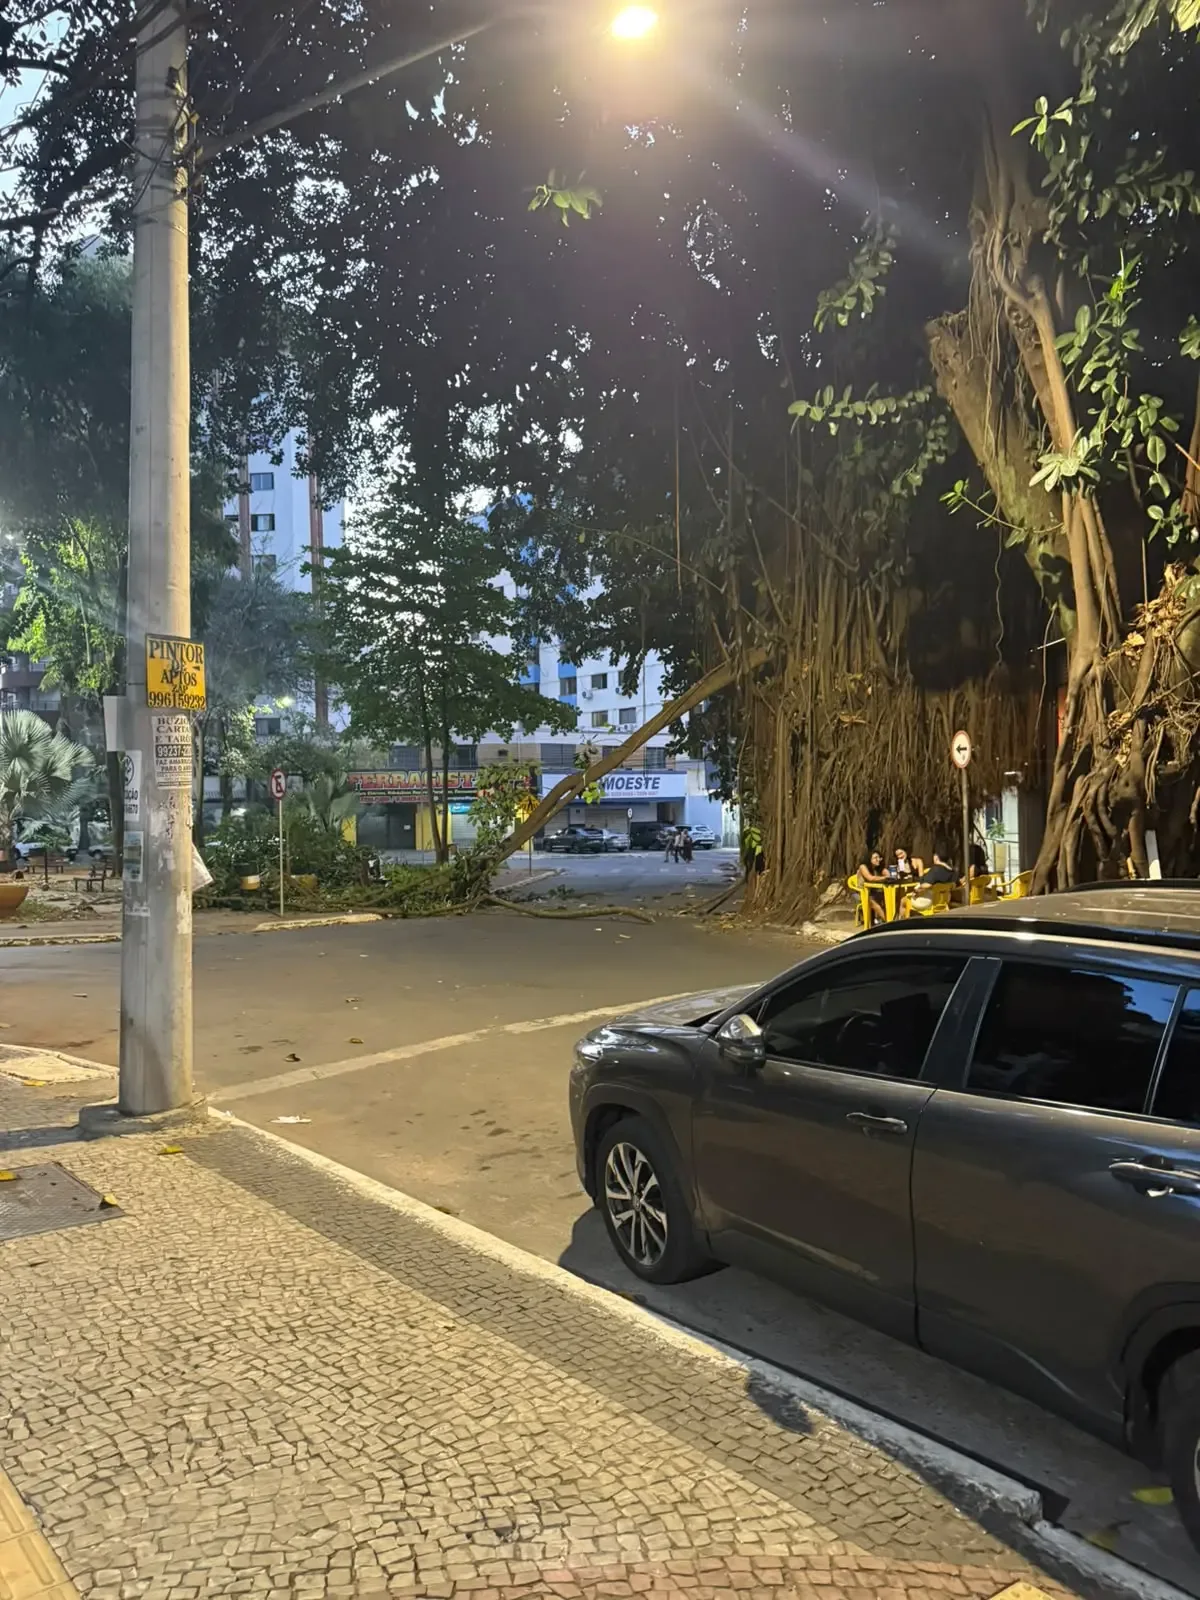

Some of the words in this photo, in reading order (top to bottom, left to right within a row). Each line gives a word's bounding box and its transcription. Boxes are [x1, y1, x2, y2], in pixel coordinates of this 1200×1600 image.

[149, 639, 204, 665] PINTOR
[160, 669, 198, 687] APTOS
[148, 691, 206, 710] 996159232
[155, 735, 163, 744] E
